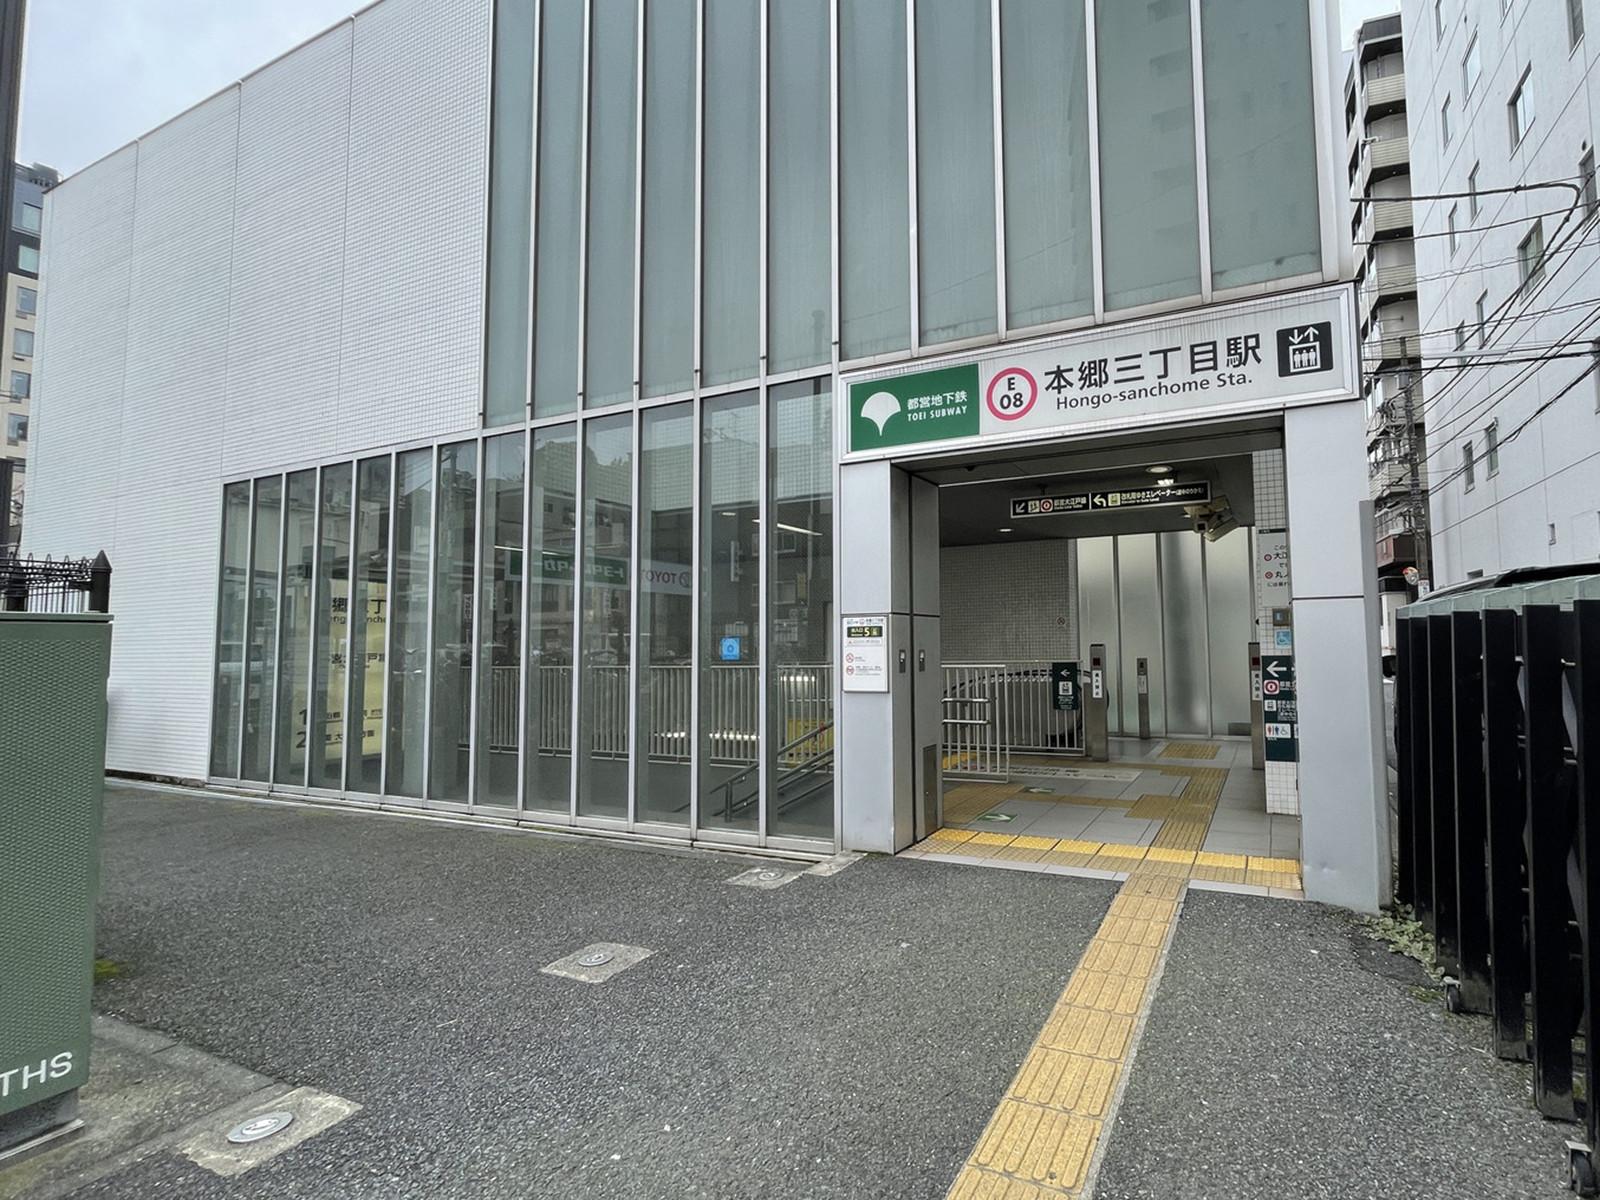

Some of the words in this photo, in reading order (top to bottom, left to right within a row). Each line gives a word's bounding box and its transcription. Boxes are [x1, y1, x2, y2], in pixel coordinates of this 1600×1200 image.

[1044, 333, 1263, 395] 本郷三丁目駅
[1007, 377, 1016, 391] E
[1056, 376, 1211, 410] Hongo-sanchome
[1217, 371, 1253, 388] Sta.
[907, 390, 968, 411] 都営地下鉄
[1000, 392, 1024, 410] 08
[907, 412, 927, 422] TOEI
[930, 405, 968, 419] SUBWAY
[864, 627, 871, 637] 5
